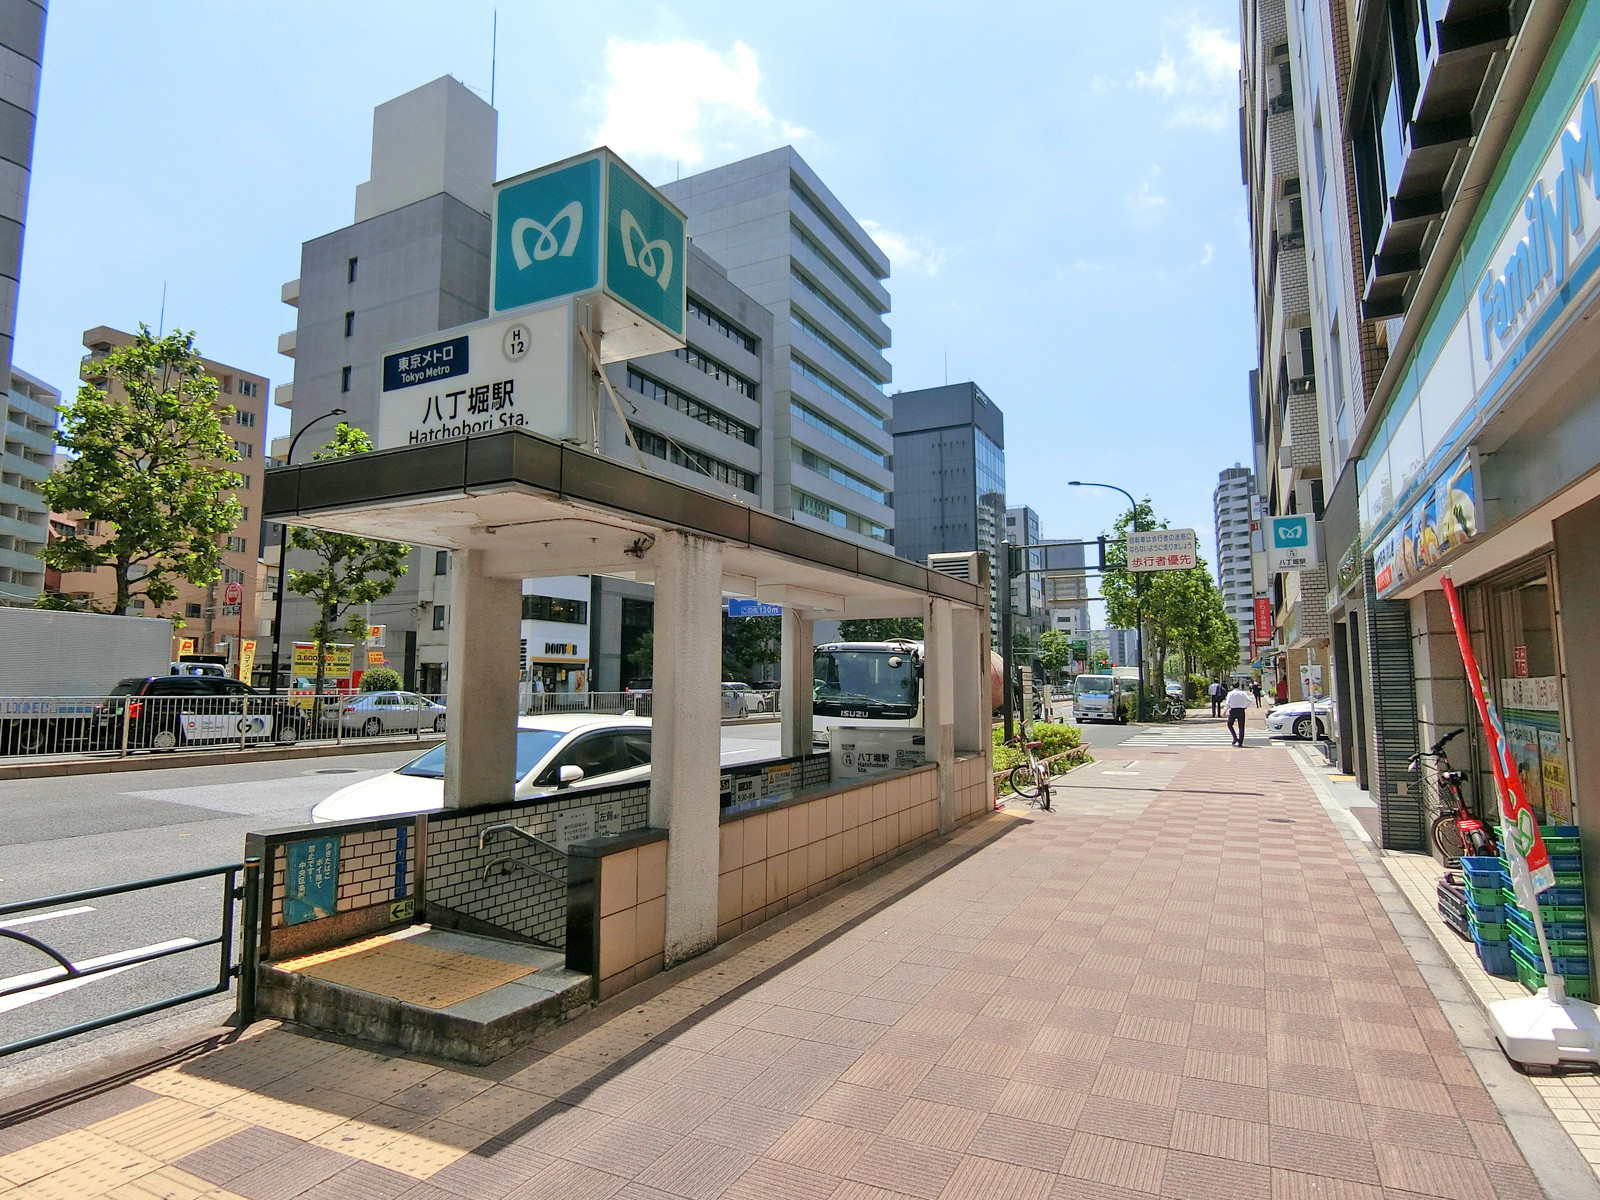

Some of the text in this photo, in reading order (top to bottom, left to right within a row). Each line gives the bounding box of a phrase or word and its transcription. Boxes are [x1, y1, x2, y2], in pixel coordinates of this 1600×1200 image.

[513, 329, 521, 341] H
[510, 342, 525, 355] 12
[398, 345, 454, 372] 東京メトロ
[401, 365, 450, 384] Tokyo Metro
[422, 379, 515, 425] 八丁堀駅
[409, 411, 529, 445] Hatchobori Sta.
[1132, 554, 1191, 568] 歩行者優先
[1279, 558, 1306, 566] 八丁堀駅
[545, 642, 578, 656] DOUTOR
[840, 710, 869, 718] ISUZU
[857, 753, 890, 763] 八丁堀駅
